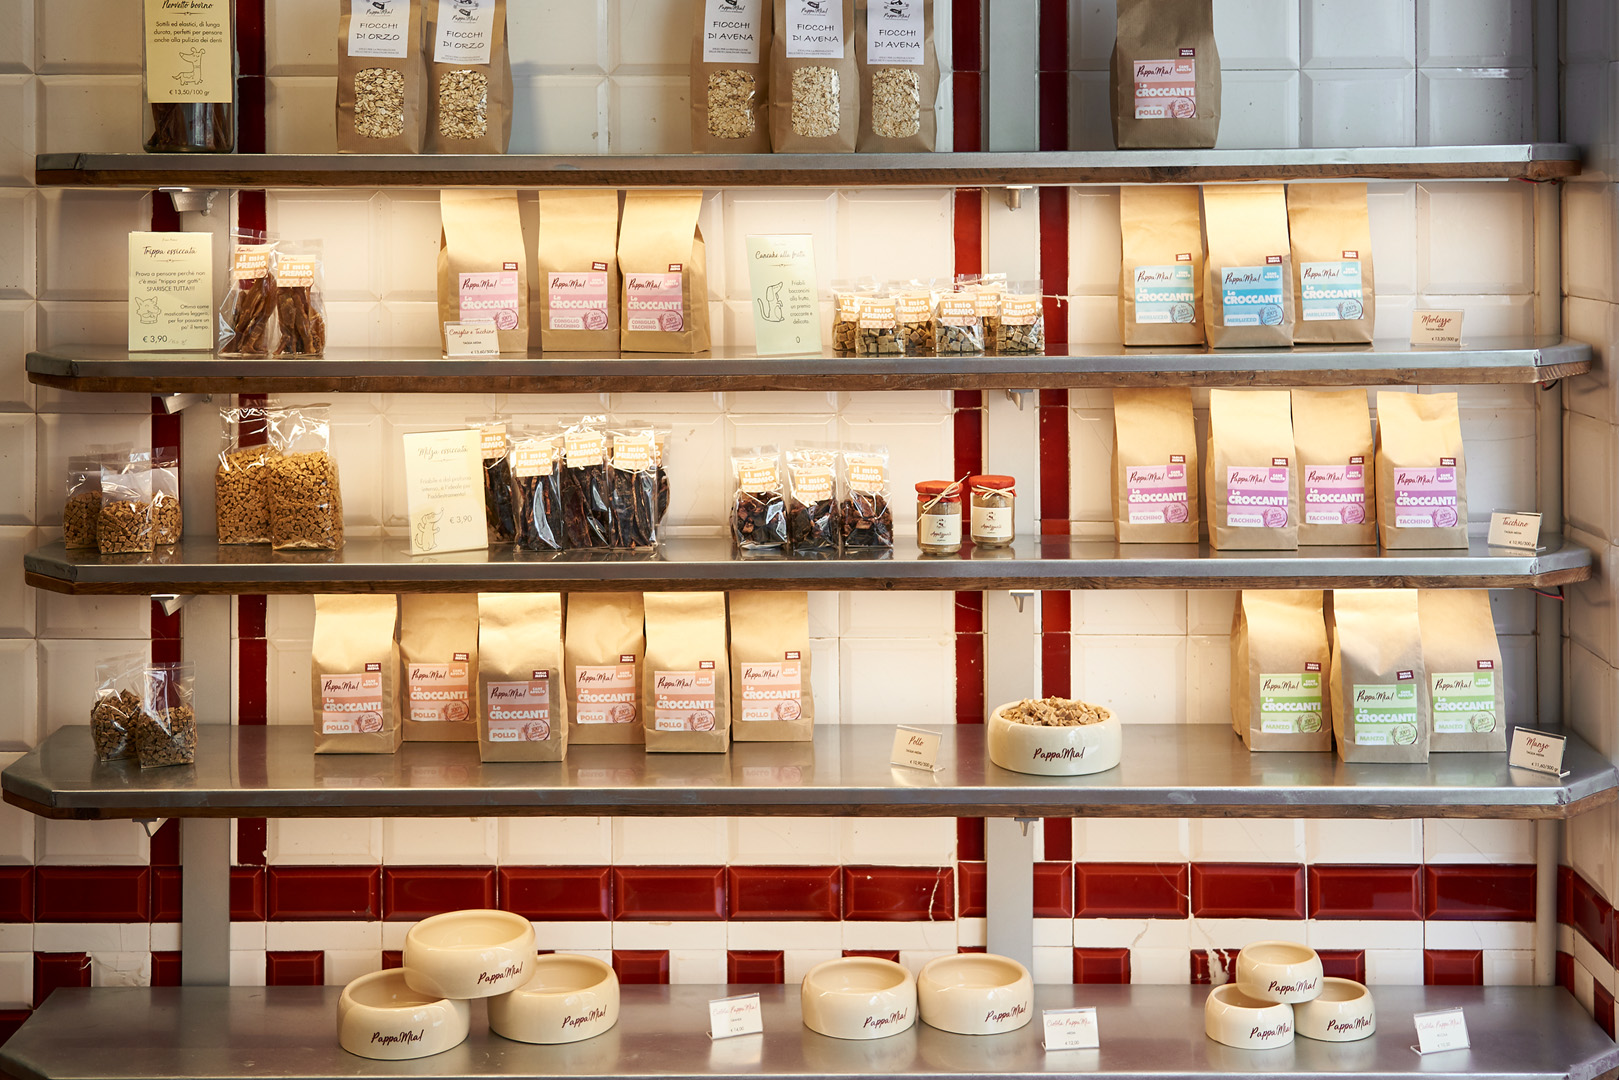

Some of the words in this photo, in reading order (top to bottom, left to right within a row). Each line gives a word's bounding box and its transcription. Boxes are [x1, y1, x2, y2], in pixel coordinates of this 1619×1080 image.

[191, 0, 214, 8] bovino
[1136, 88, 1194, 97] CROCCANTI
[143, 246, 164, 258] Trippa
[1136, 293, 1193, 302] CROCCANTI
[1303, 290, 1361, 299] CROCCANTI
[1224, 295, 1282, 304] CROCCANTI
[461, 300, 517, 309] CROCCANTI
[550, 300, 607, 309] CROCCANTI
[628, 301, 681, 310] CROCCANTI
[151, 335, 167, 343] 3,90
[568, 448, 600, 456] PREMIO
[743, 476, 774, 484] PREMIO
[1129, 492, 1186, 502] CROCCANTI
[1228, 495, 1287, 505] CROCCANTI
[1306, 494, 1364, 502] CROCCANTI
[1396, 496, 1456, 506] CROCCANTI
[457, 515, 472, 524] 3,90
[411, 691, 467, 700] CROCCANTI
[578, 693, 634, 702] CROCCANTI
[743, 690, 799, 699] CROCCANTI
[324, 702, 381, 712] CROCCANTI
[656, 700, 714, 709] CROCCANTI
[1262, 702, 1320, 711] CROCCANTI
[1434, 702, 1494, 711] CROCCANTI
[489, 710, 548, 720] CROCCANTI
[1356, 713, 1416, 722] CROCCANTI
[908, 736, 924, 746] Pollo
[1526, 737, 1549, 752] Manzo
